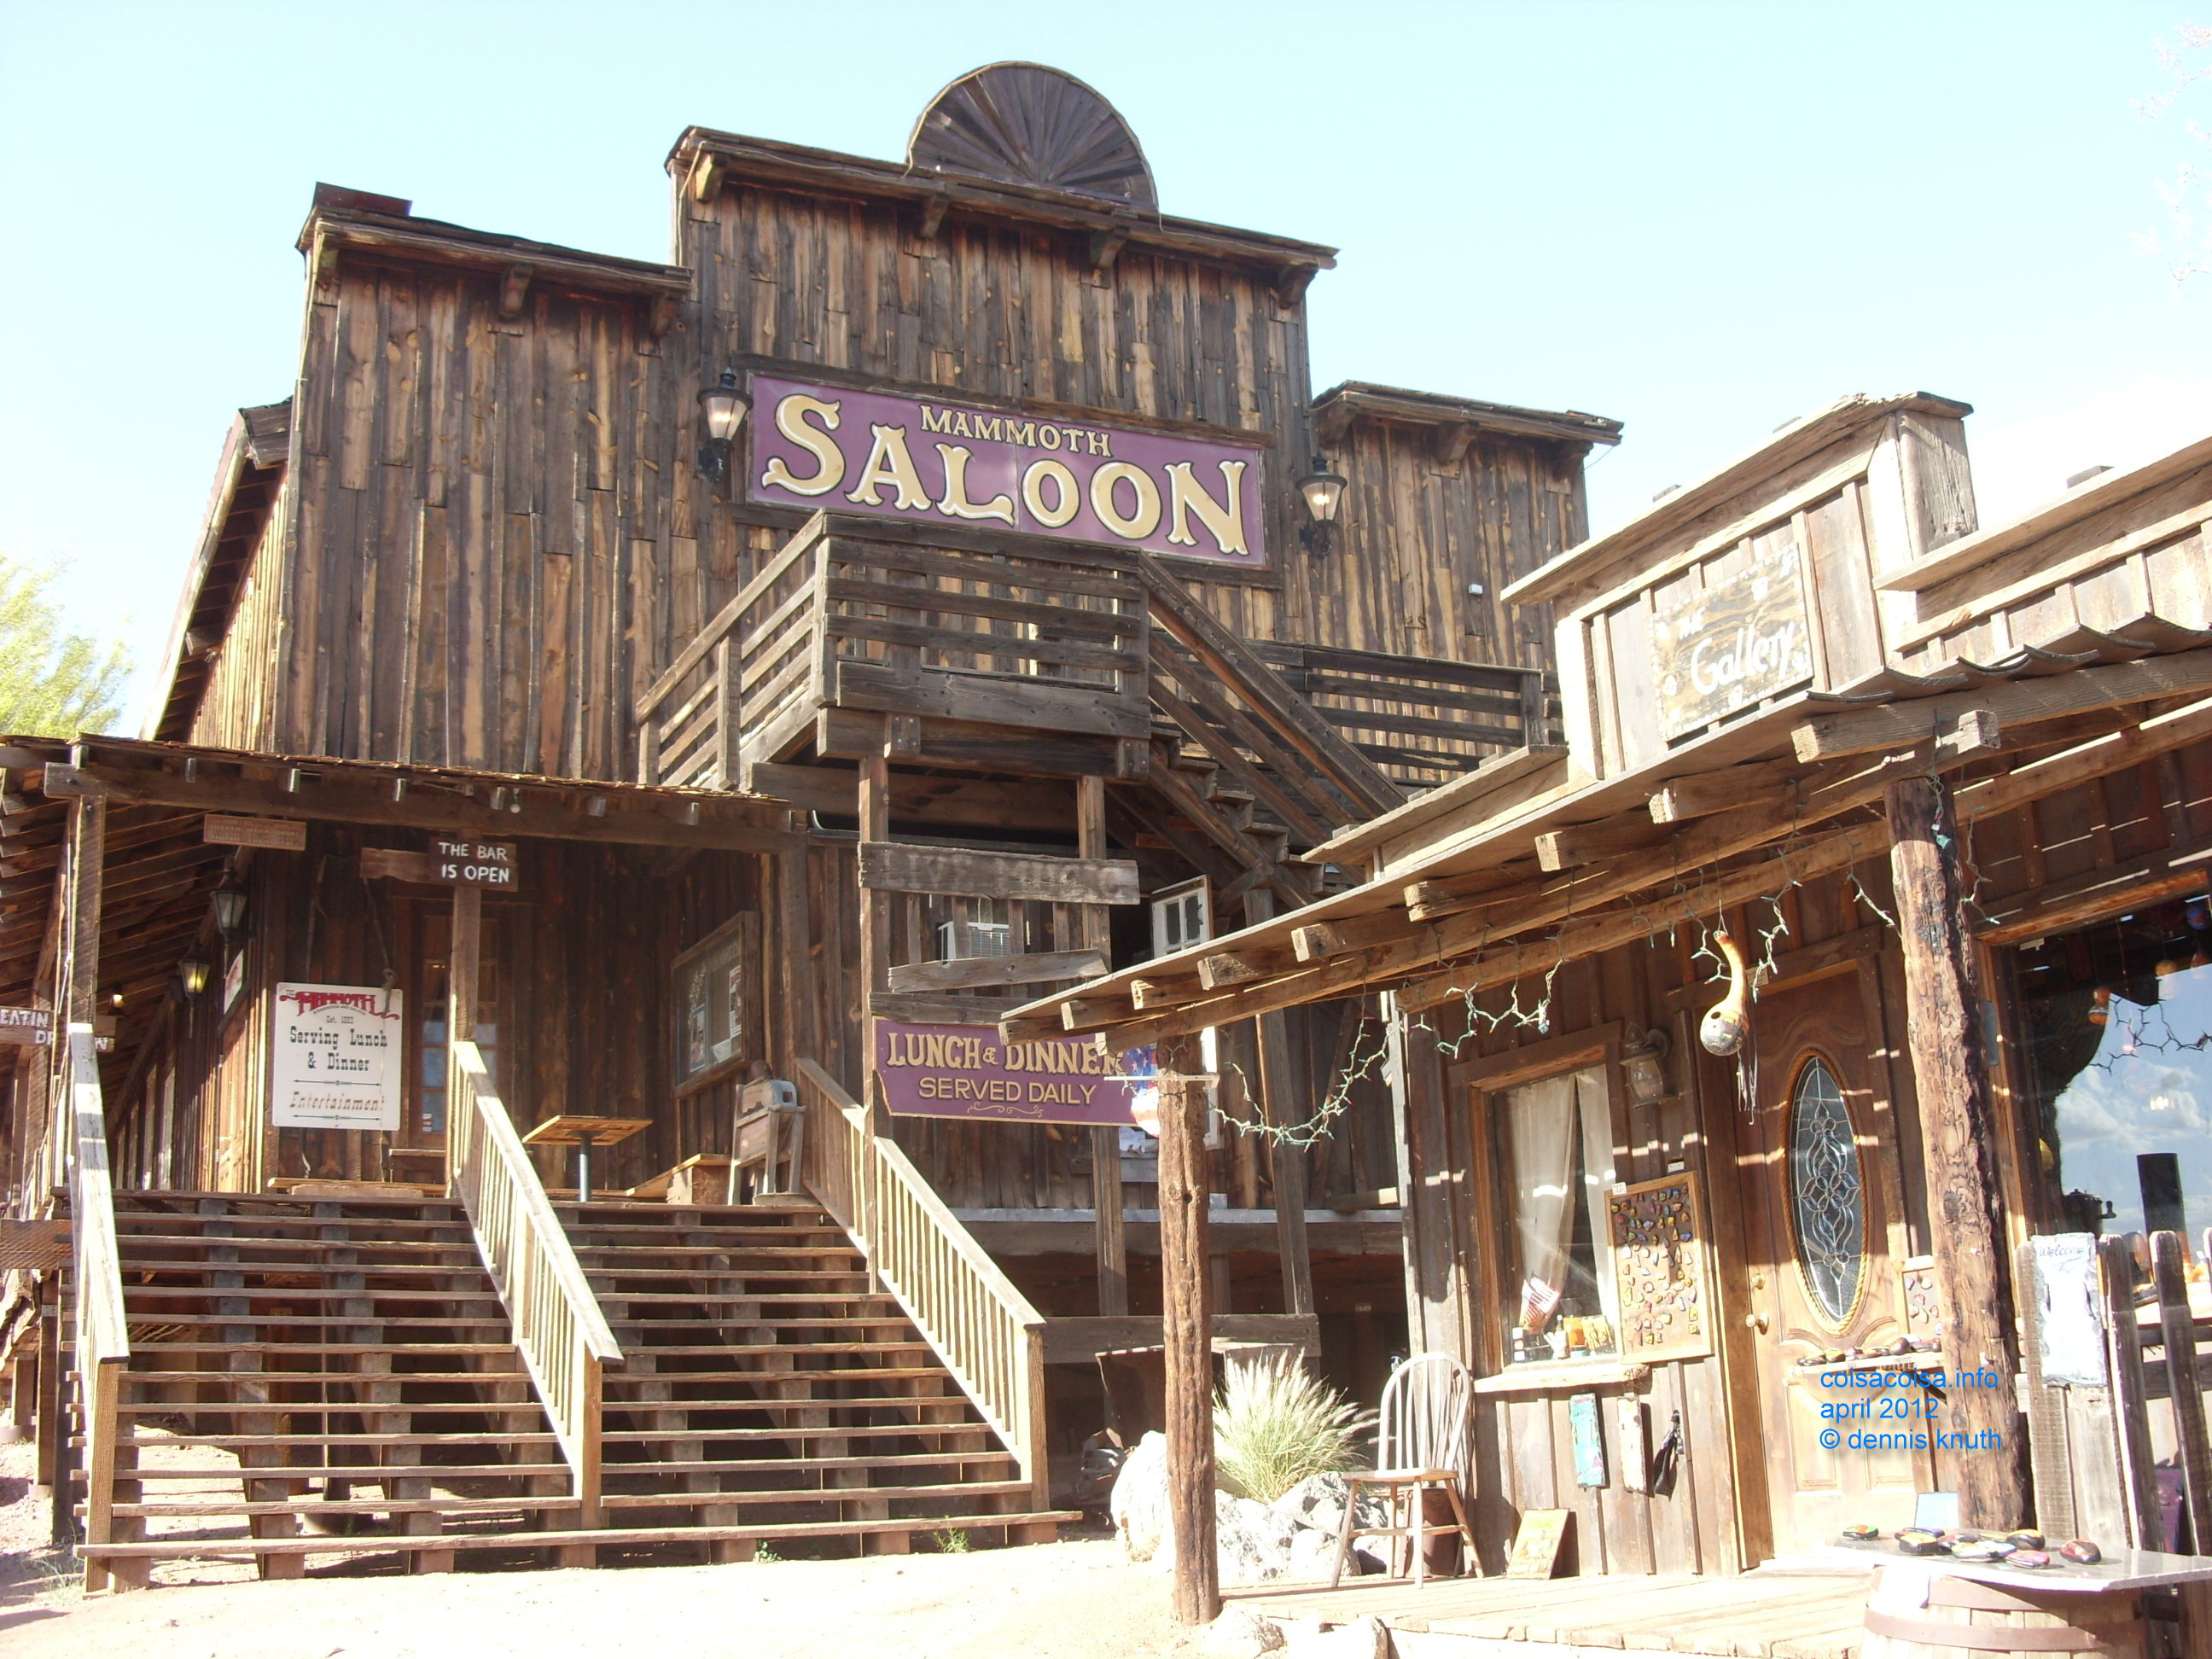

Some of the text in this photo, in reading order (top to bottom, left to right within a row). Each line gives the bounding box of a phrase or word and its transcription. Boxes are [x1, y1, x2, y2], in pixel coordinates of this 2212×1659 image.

[920, 405, 1112, 458] MAMMOTH
[761, 393, 1250, 556] SALOON
[1690, 621, 1794, 696] Gallery
[438, 841, 508, 862] THE BAR
[441, 864, 510, 884] IS OPEN
[290, 1025, 387, 1050] Serving Lunch
[307, 1051, 370, 1071] & Dinner
[887, 1032, 982, 1070] LUNCH
[981, 1046, 998, 1066] &
[290, 1090, 385, 1111] Entertainment
[918, 1077, 1097, 1105] SERVED DAILY
